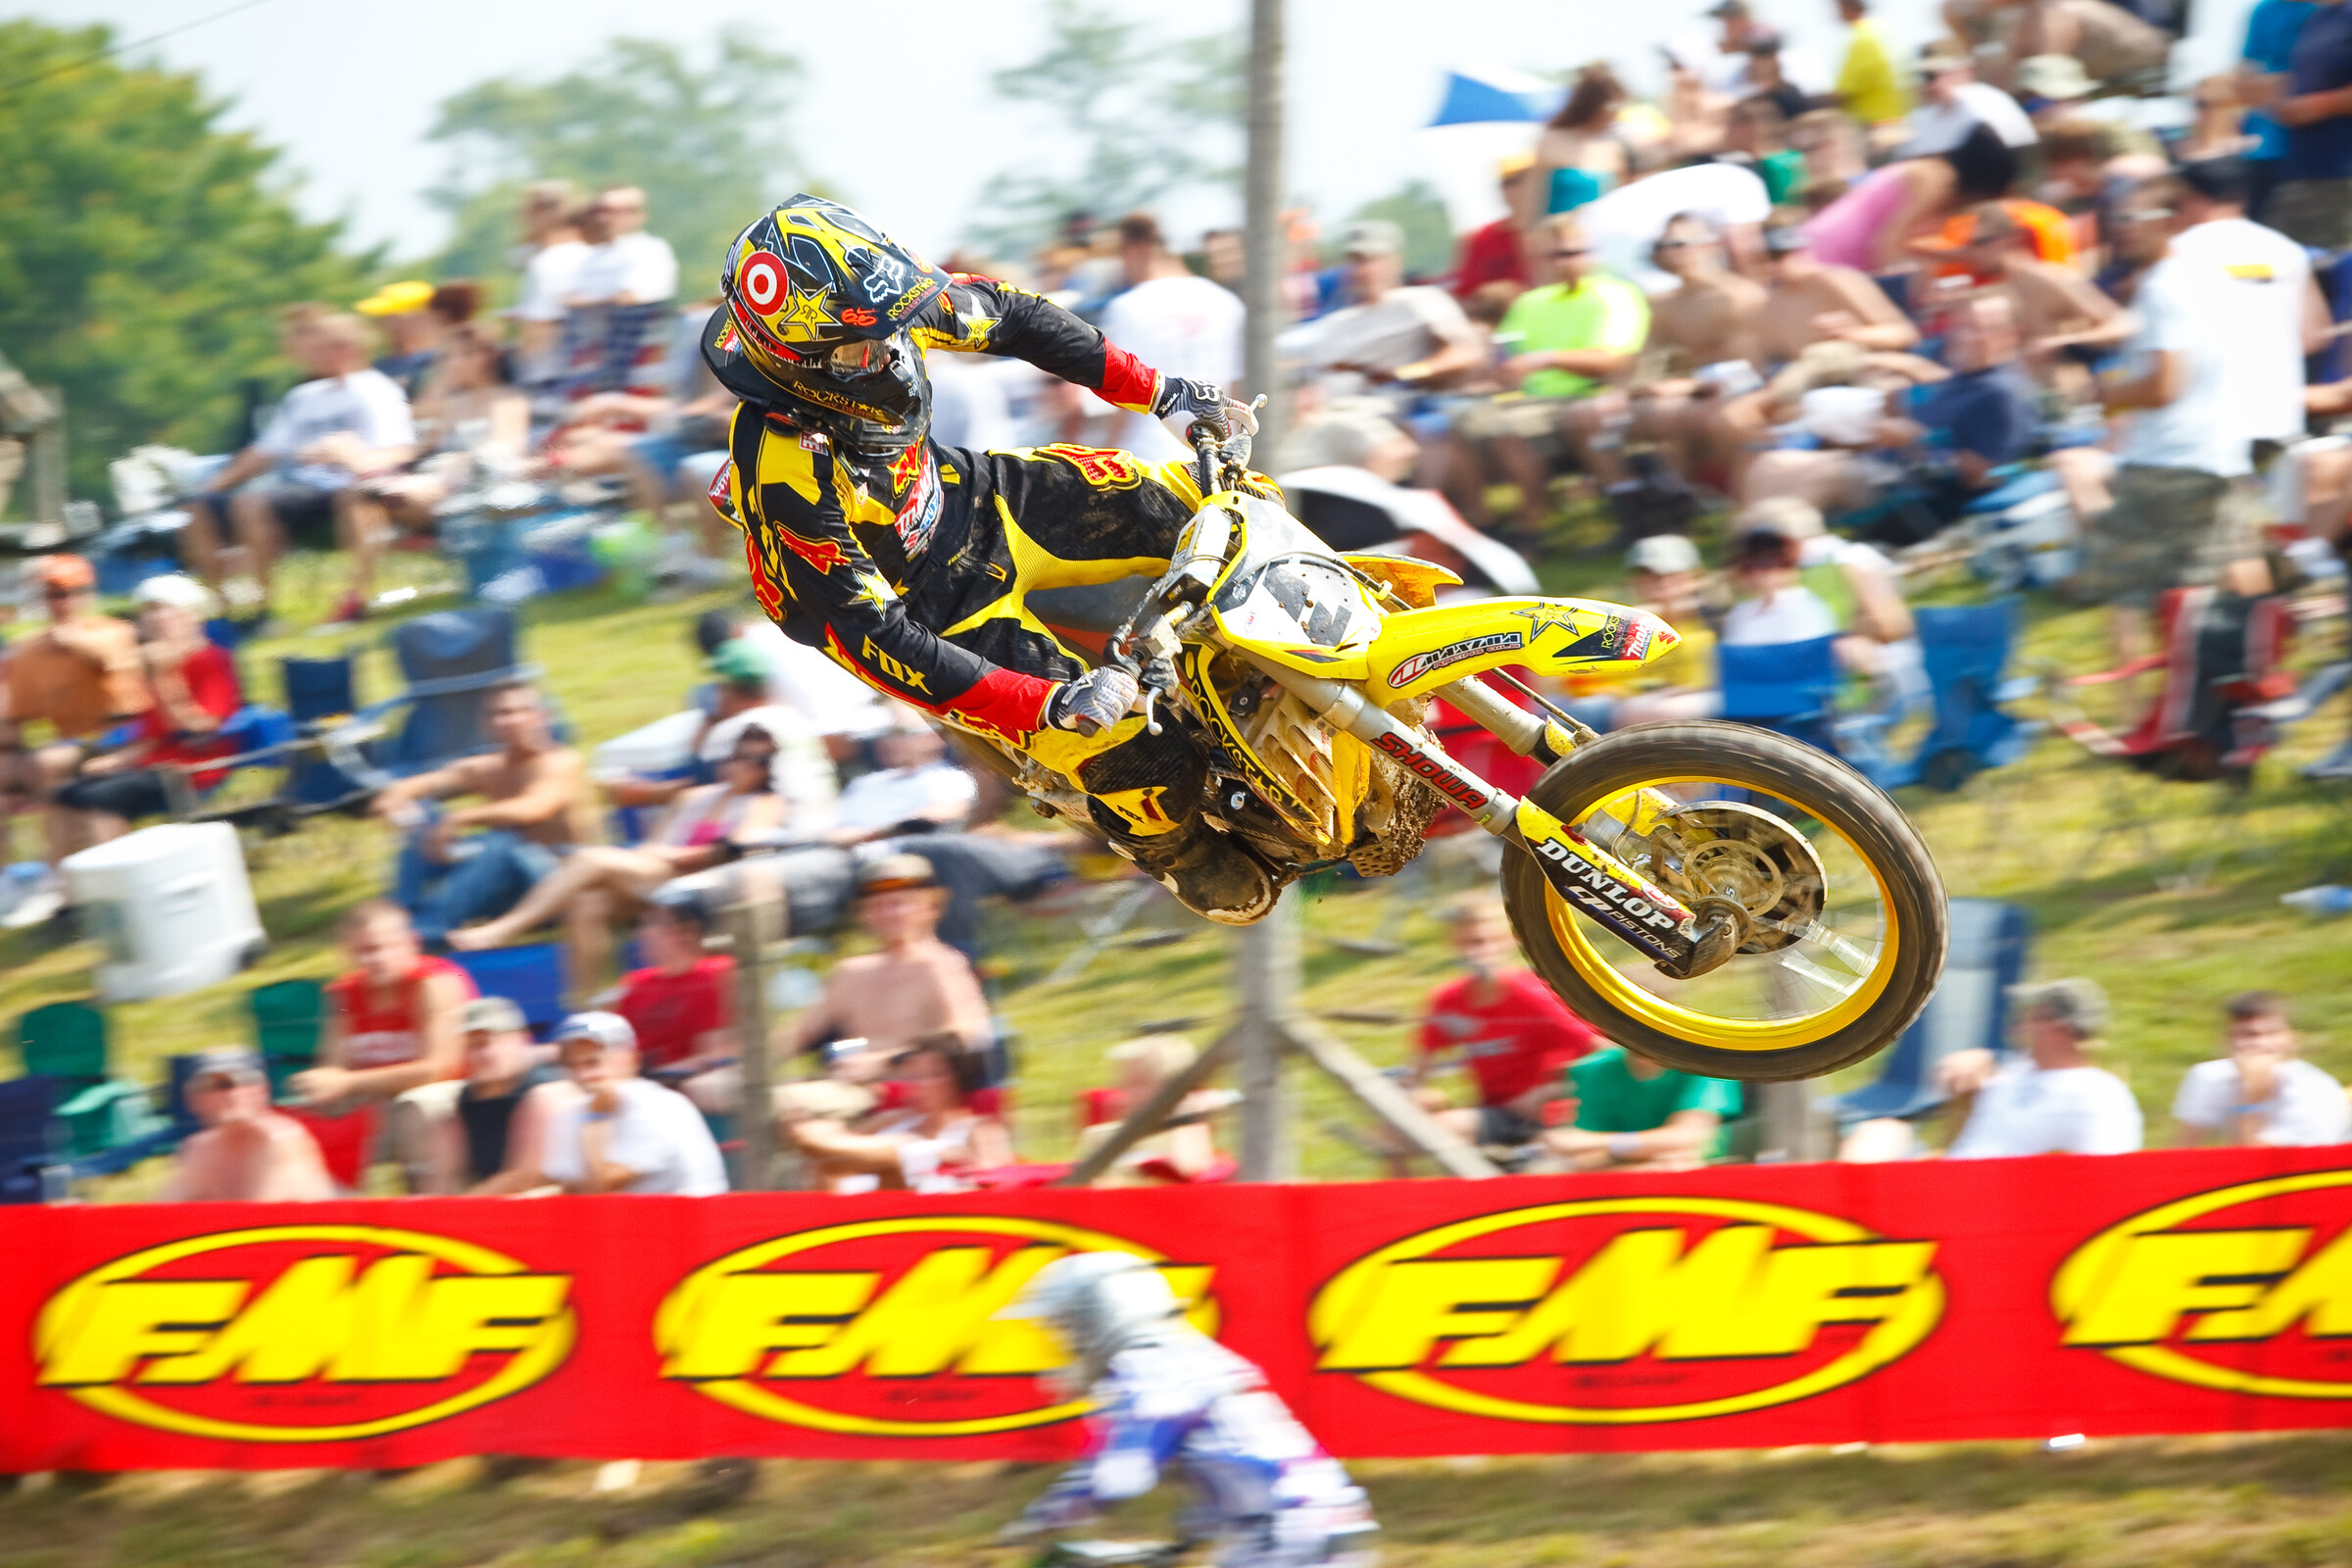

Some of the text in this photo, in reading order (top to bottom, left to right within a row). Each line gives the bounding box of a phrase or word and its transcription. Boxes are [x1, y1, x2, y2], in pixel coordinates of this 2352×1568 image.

[861, 634, 933, 697] FOX
[1372, 731, 1489, 810] SHOWA
[1536, 838, 1676, 930] DUNLOP
[1610, 909, 1682, 959] PISTONS
[35, 1252, 574, 1387] FMF
[1315, 1222, 1940, 1373] FMF
